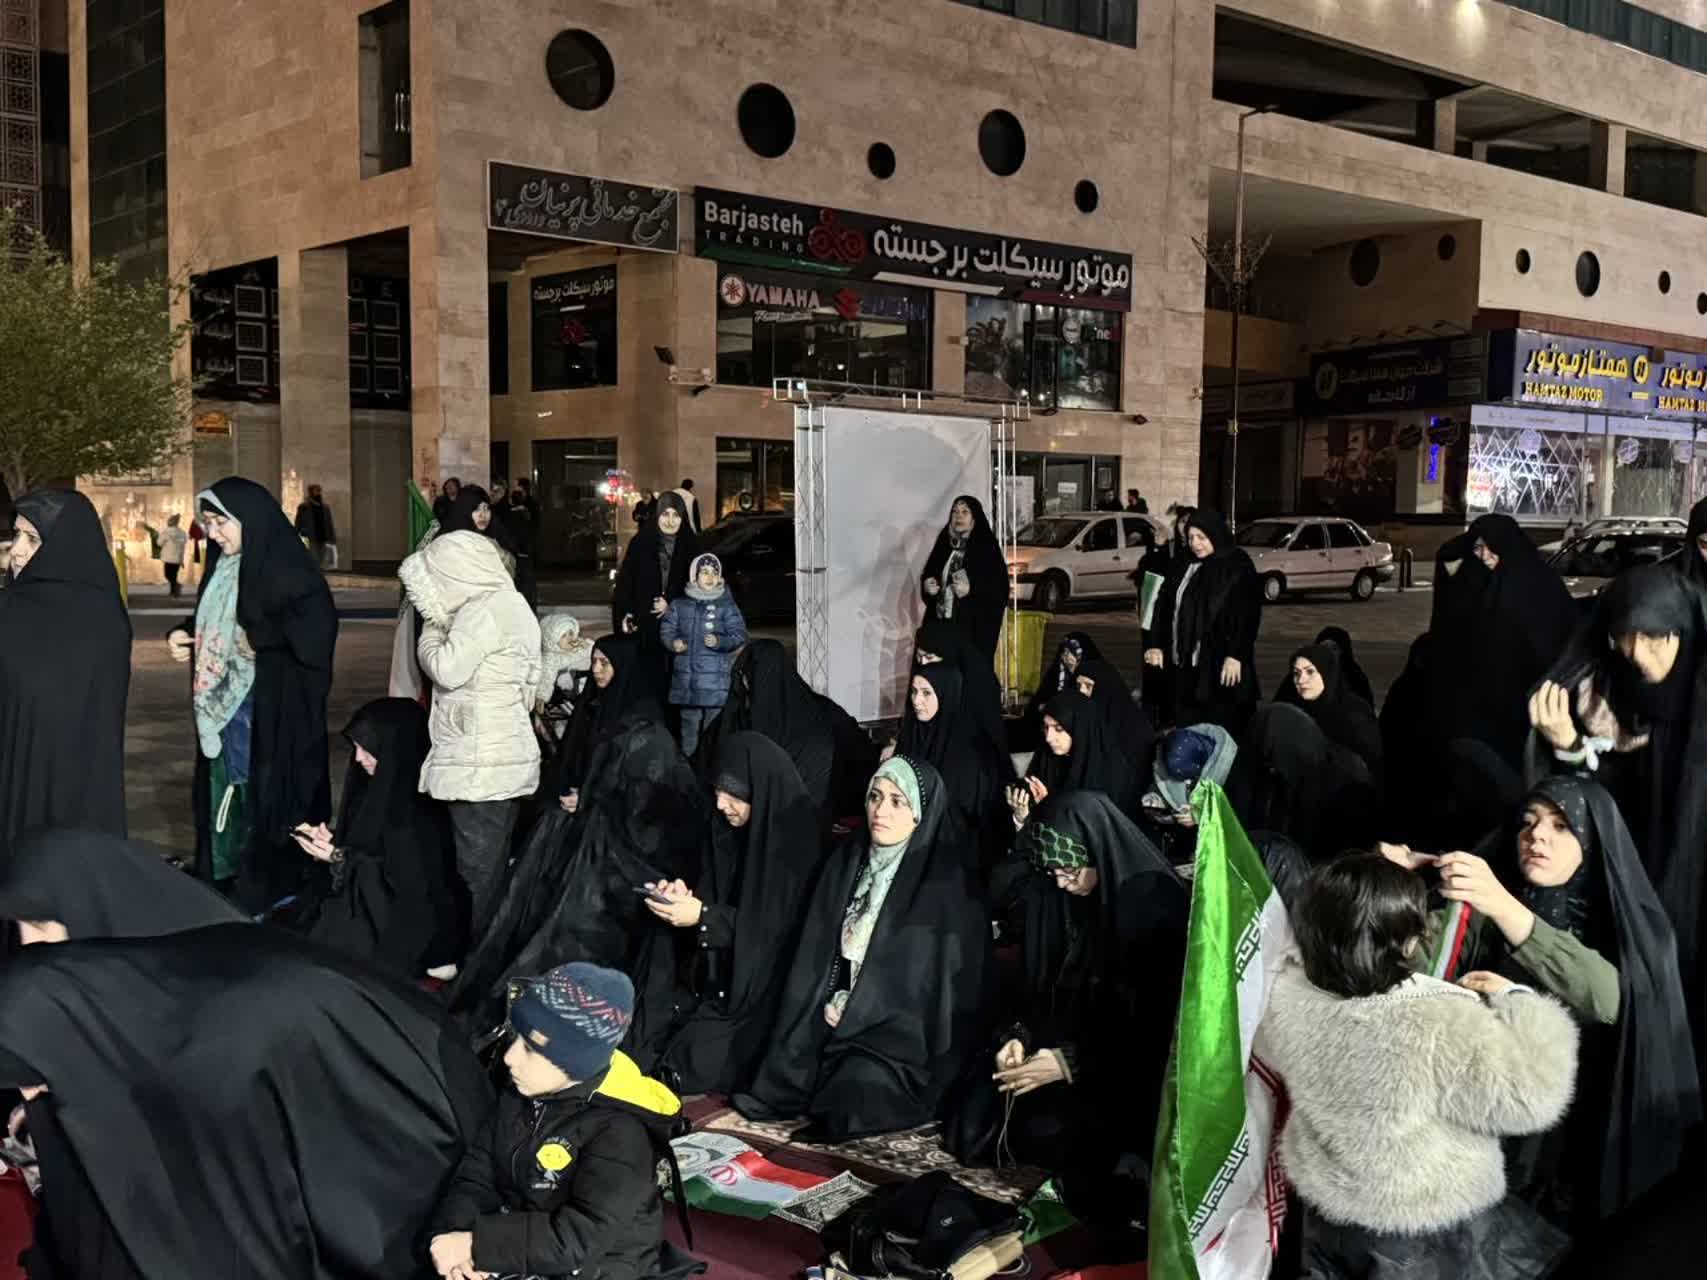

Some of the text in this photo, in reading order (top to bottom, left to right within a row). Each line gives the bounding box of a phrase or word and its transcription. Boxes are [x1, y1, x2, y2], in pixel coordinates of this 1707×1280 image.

[703, 200, 805, 236] Barjasteh
[704, 229, 806, 253] TRADING
[873, 223, 969, 279] برجسته
[746, 282, 820, 310] YAMAHA
[1525, 381, 1604, 402] HAMTAZ MOTOR
[1658, 395, 1695, 412] HAMTAZ
